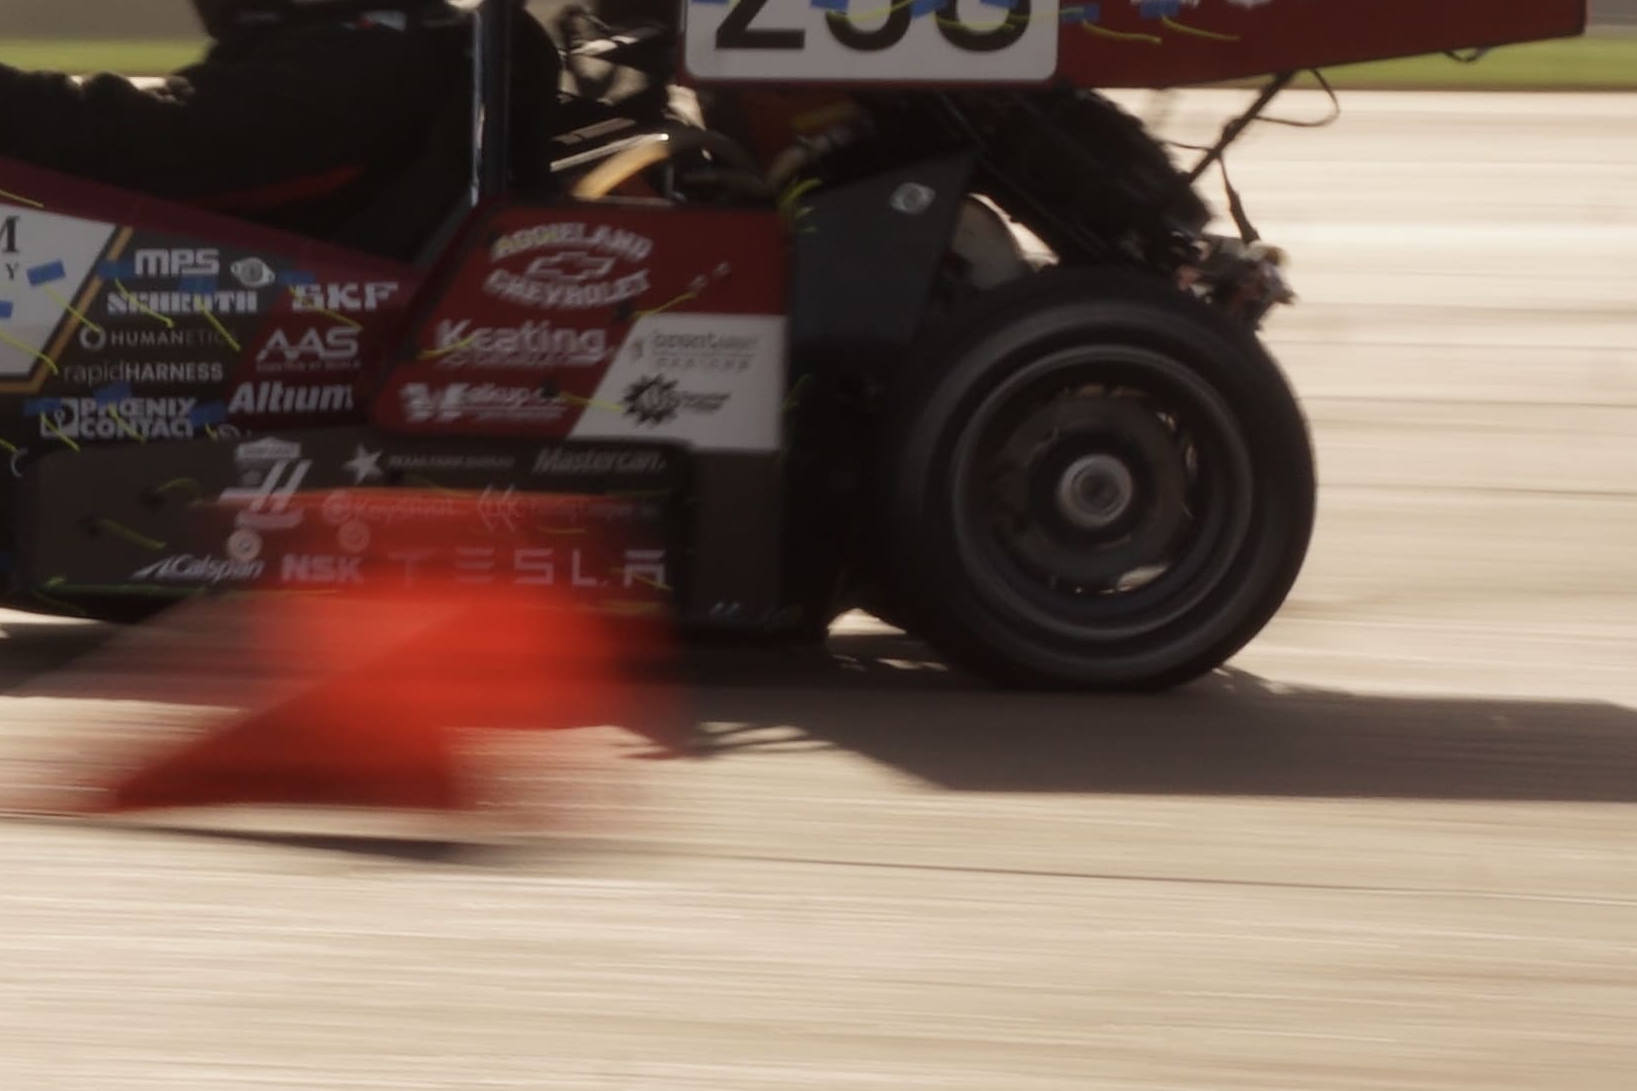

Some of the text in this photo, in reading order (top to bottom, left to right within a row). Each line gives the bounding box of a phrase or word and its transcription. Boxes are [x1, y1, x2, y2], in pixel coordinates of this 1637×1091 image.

[292, 282, 399, 311] SKF
[256, 327, 359, 359] AAS
[65, 360, 223, 386] rapidHARNESS
[228, 381, 355, 414] Altium
[281, 554, 363, 582] NSK
[388, 548, 665, 587] TESLA
